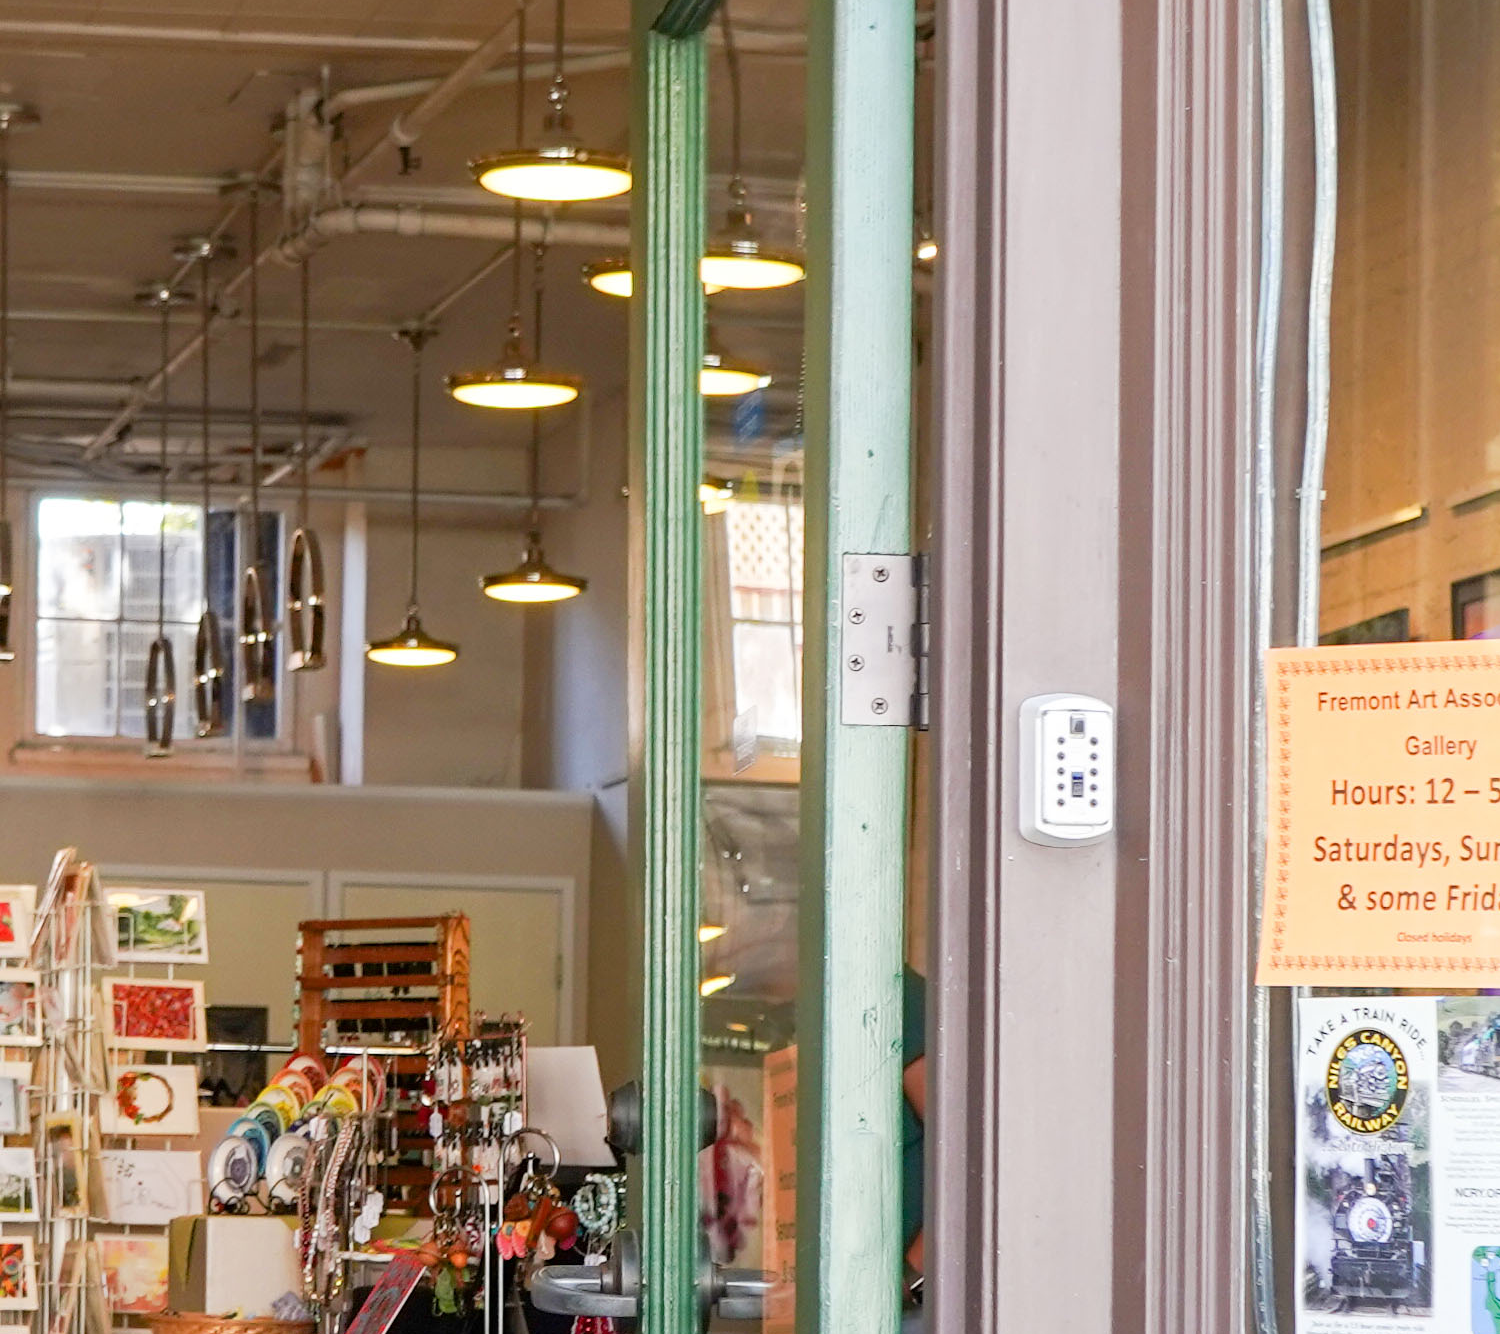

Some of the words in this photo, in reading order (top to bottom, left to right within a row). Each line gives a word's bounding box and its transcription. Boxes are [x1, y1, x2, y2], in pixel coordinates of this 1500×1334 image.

[1317, 691, 1400, 712] Fremont
[1406, 689, 1438, 710] Art
[1405, 735, 1478, 760] Gallery
[1331, 779, 1415, 806] Hours:
[1425, 778, 1456, 804] 12
[1314, 834, 1451, 867] Saturdays,
[1337, 884, 1357, 911] &
[1366, 889, 1437, 911] some
[1397, 932, 1429, 944] Closed
[1431, 932, 1473, 945] holidays
[1306, 1019, 1337, 1055] TAKE
[1340, 1013, 1349, 1025] A
[1352, 1007, 1396, 1023] TRAIN
[1328, 1037, 1358, 1089] NILES
[1360, 1032, 1408, 1090] CANYON
[1333, 1101, 1399, 1131] RAILWAY
